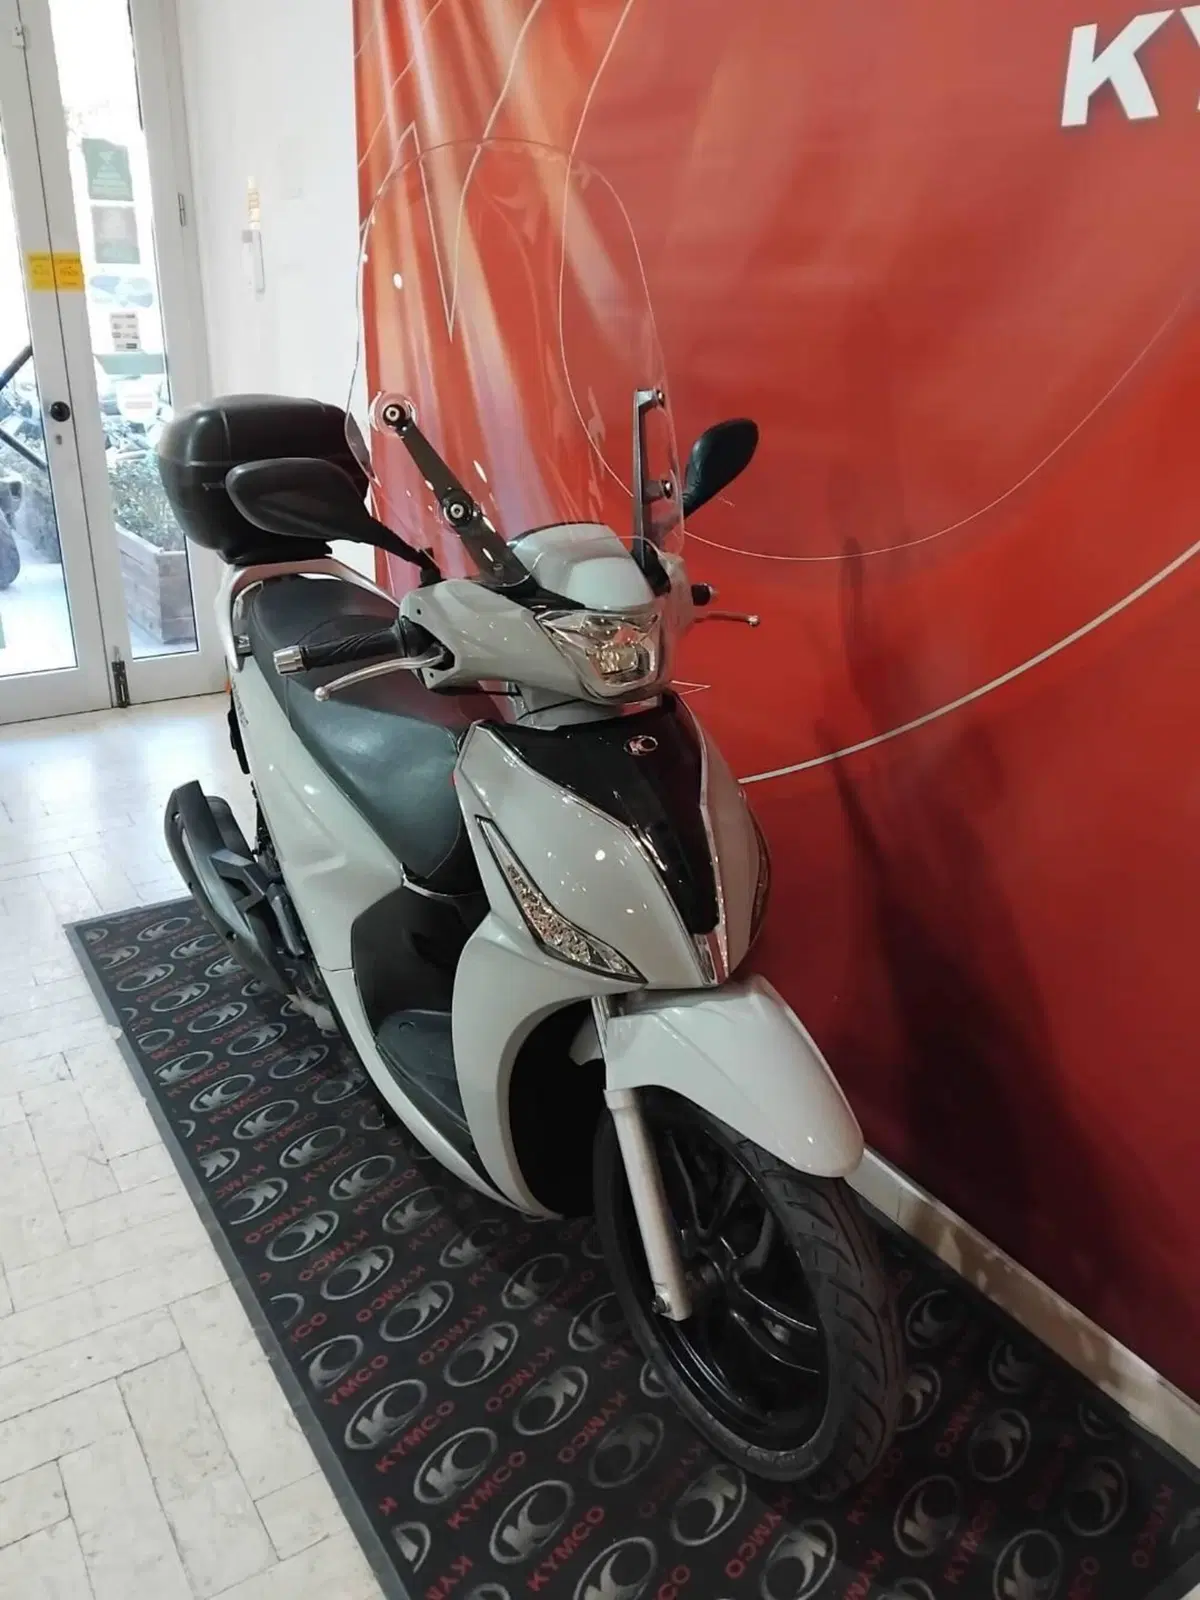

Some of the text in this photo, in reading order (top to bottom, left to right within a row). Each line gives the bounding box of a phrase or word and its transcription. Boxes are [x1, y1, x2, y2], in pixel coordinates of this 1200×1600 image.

[1061, 4, 1200, 127] K
[244, 1195, 317, 1244] KYMCO
[300, 1228, 369, 1281] KYMCO
[356, 1265, 425, 1323] KYMCO
[417, 1304, 488, 1365] KYMCO
[486, 1346, 555, 1411] KYMCO
[375, 1400, 455, 1473] KYMCO
[557, 1390, 628, 1463] KYMCO
[447, 1450, 527, 1529] KYMCO
[526, 1505, 606, 1591] KYMCO
